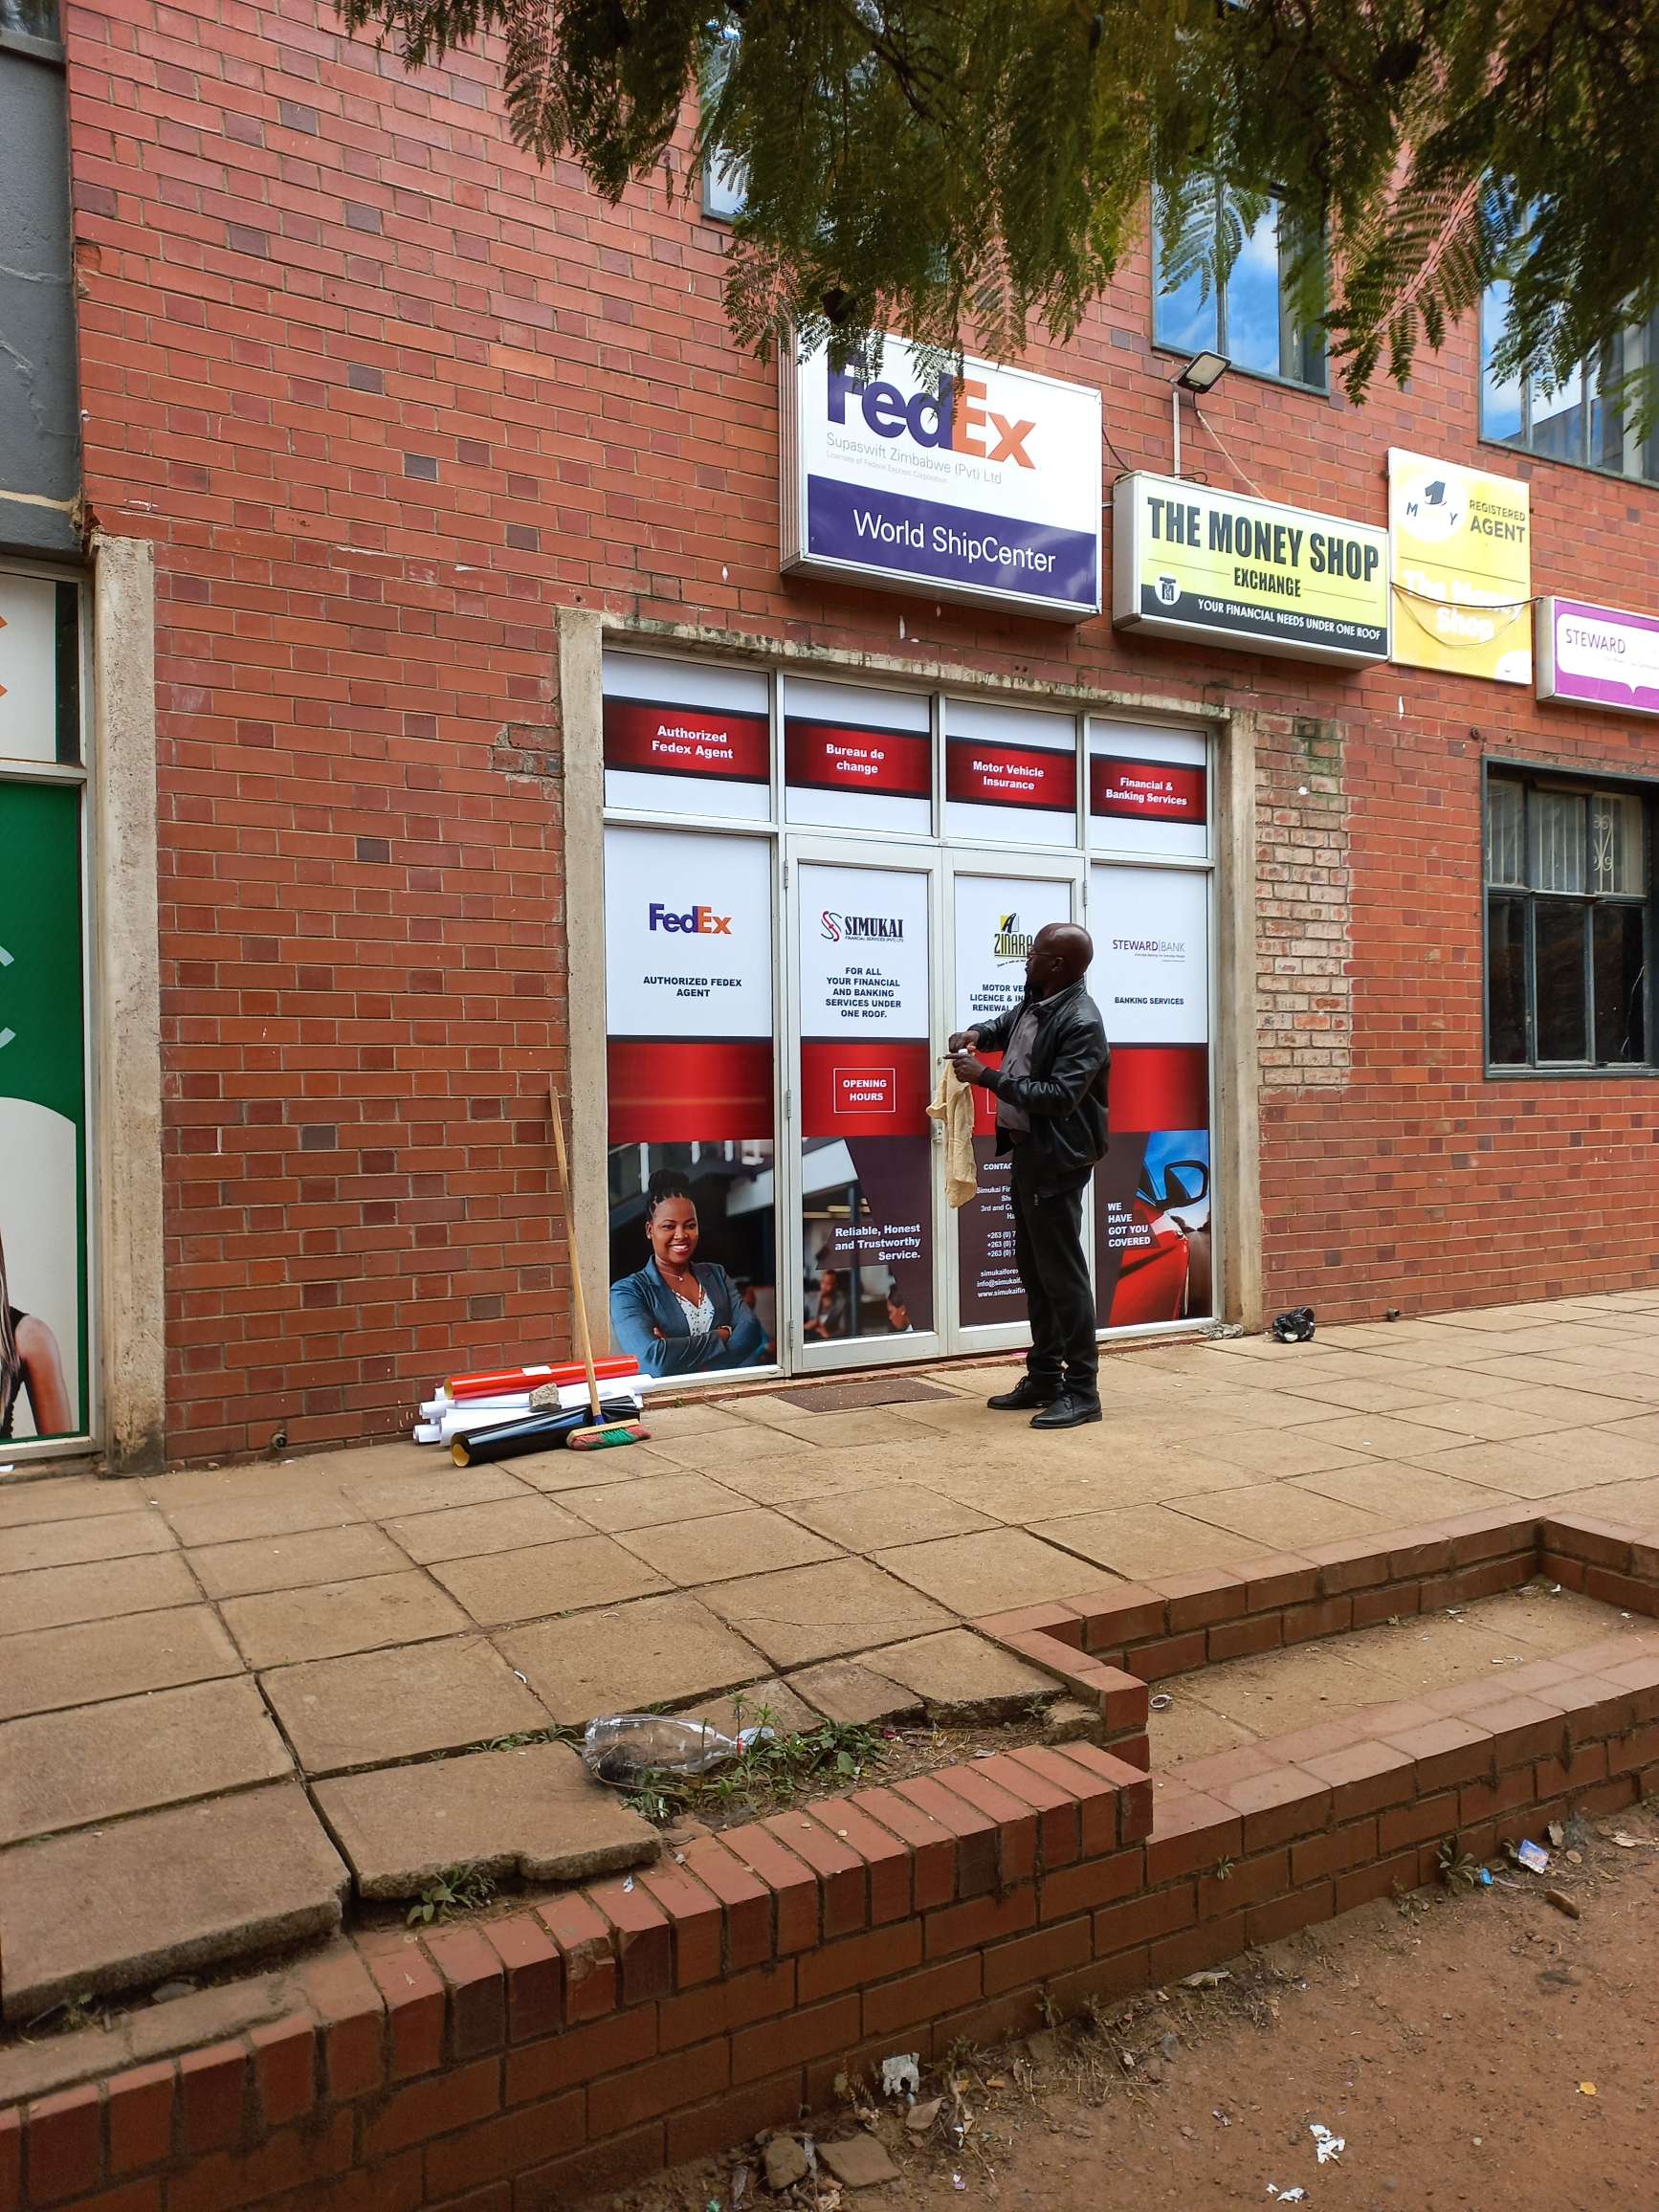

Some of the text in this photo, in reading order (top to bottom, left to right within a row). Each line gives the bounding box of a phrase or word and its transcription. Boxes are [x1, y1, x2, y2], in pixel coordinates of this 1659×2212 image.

[828, 341, 1036, 470] FedEx
[827, 431, 1002, 484] Supaswift Zimbabwe (Pvt) Ltd
[1469, 498, 1526, 521] REGISTERED
[1470, 515, 1526, 542] AGENT
[852, 509, 1056, 573] World ShipCenter
[1147, 497, 1379, 582] THE MONEY SHOP
[1234, 566, 1301, 598] EXCHANGE
[1198, 598, 1381, 640] YOUR FINANCIAL NEEDS UNDER ONE ROOF
[1565, 629, 1626, 654] STEWARD
[657, 725, 727, 743] Authorized
[652, 741, 734, 759] Fedex Agent
[826, 743, 885, 760] Bureau de
[836, 761, 878, 775] change
[973, 761, 1045, 778] Motor Vehicle
[983, 776, 1035, 790] Insurance
[1120, 777, 1173, 791] Financial &
[1106, 789, 1187, 806] Banking Services
[649, 902, 732, 935] FedEx
[845, 916, 904, 938] SIMUKAI
[1113, 939, 1185, 952] STEWARD BANK
[643, 976, 742, 987] AUTHORIZED FEDEX
[827, 977, 900, 986] YOUR FINANCIAL
[982, 984, 1011, 992] MOTOR
[675, 988, 711, 998] AGENT
[832, 987, 895, 997] AND BANKING
[969, 993, 1005, 1002] LICENCE
[825, 998, 870, 1006] SERVICES
[1115, 996, 1184, 1006] BANKING SERVICES
[842, 1079, 887, 1088] OPENING
[849, 1093, 884, 1101] HOURS
[1107, 1202, 1122, 1211] WE
[1107, 1213, 1133, 1223] HAVE
[835, 1224, 920, 1236] Reliable, Honest
[1108, 1225, 1149, 1235] GOT YOU
[835, 1236, 920, 1250] and Trustworthy
[1108, 1236, 1151, 1247] COVERED
[878, 1250, 920, 1260] Service.
[977, 1288, 1026, 1297] www.simukaifin
